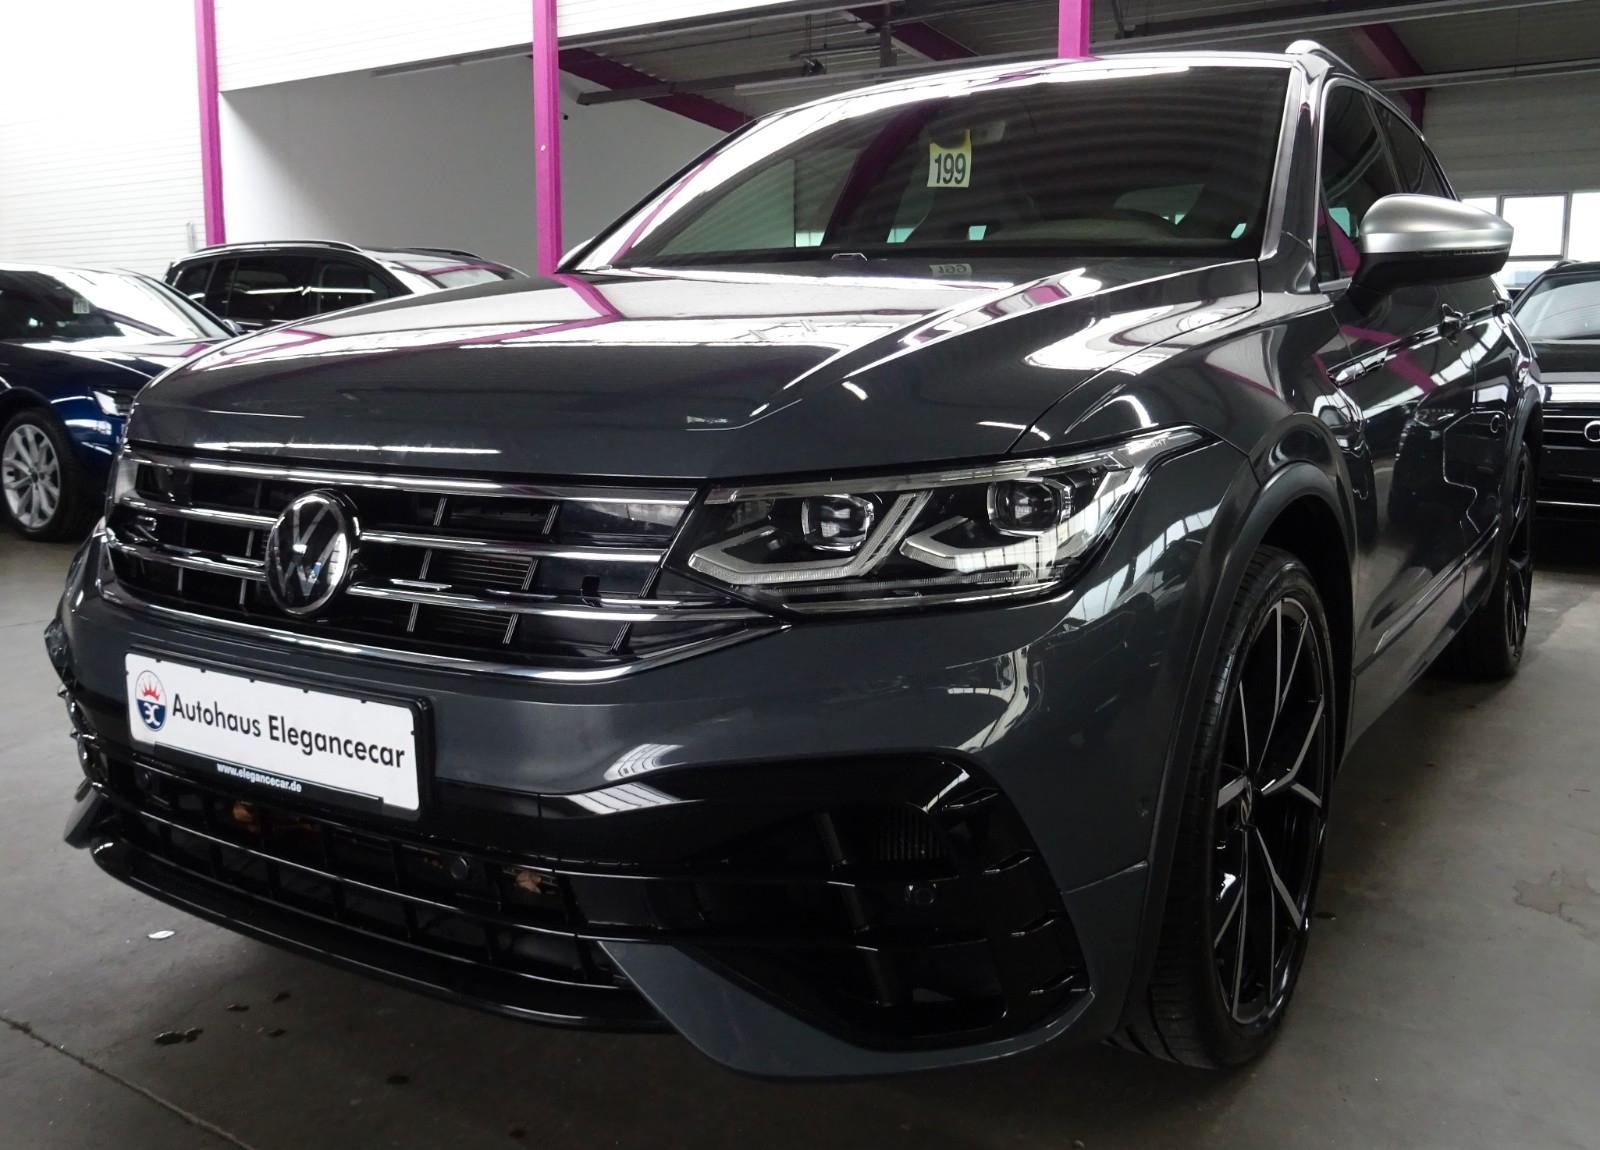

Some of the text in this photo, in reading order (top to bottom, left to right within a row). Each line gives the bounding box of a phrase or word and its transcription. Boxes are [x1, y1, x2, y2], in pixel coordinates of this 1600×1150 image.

[934, 152, 967, 185] 199
[172, 692, 406, 768] Autohaus Elegancecar
[216, 762, 302, 793] www.elegancecar.de
